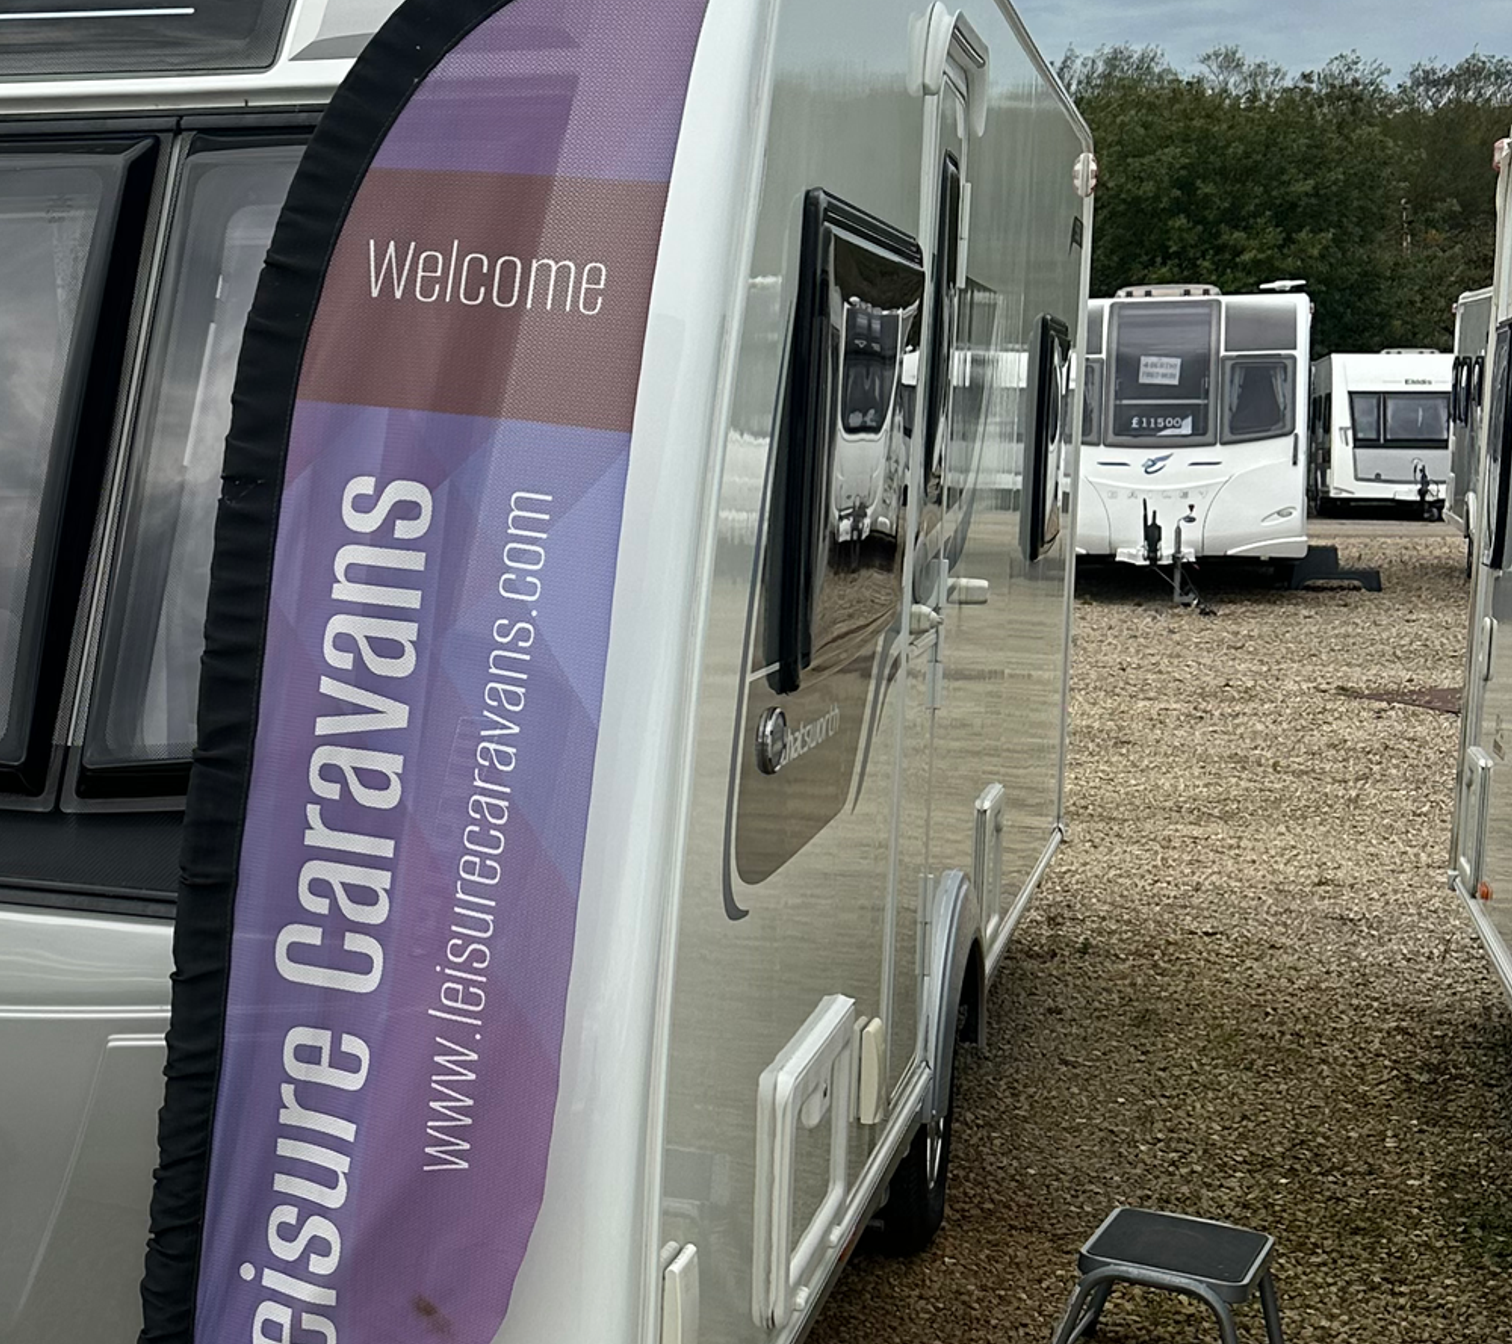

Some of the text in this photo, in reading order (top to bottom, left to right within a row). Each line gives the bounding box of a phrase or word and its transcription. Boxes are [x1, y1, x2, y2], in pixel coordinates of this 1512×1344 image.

[367, 238, 608, 316] Welcome
[1131, 416, 1182, 428] £11500
[274, 475, 434, 994] Caravans
[422, 489, 554, 1172] www.leisurecaravans.com
